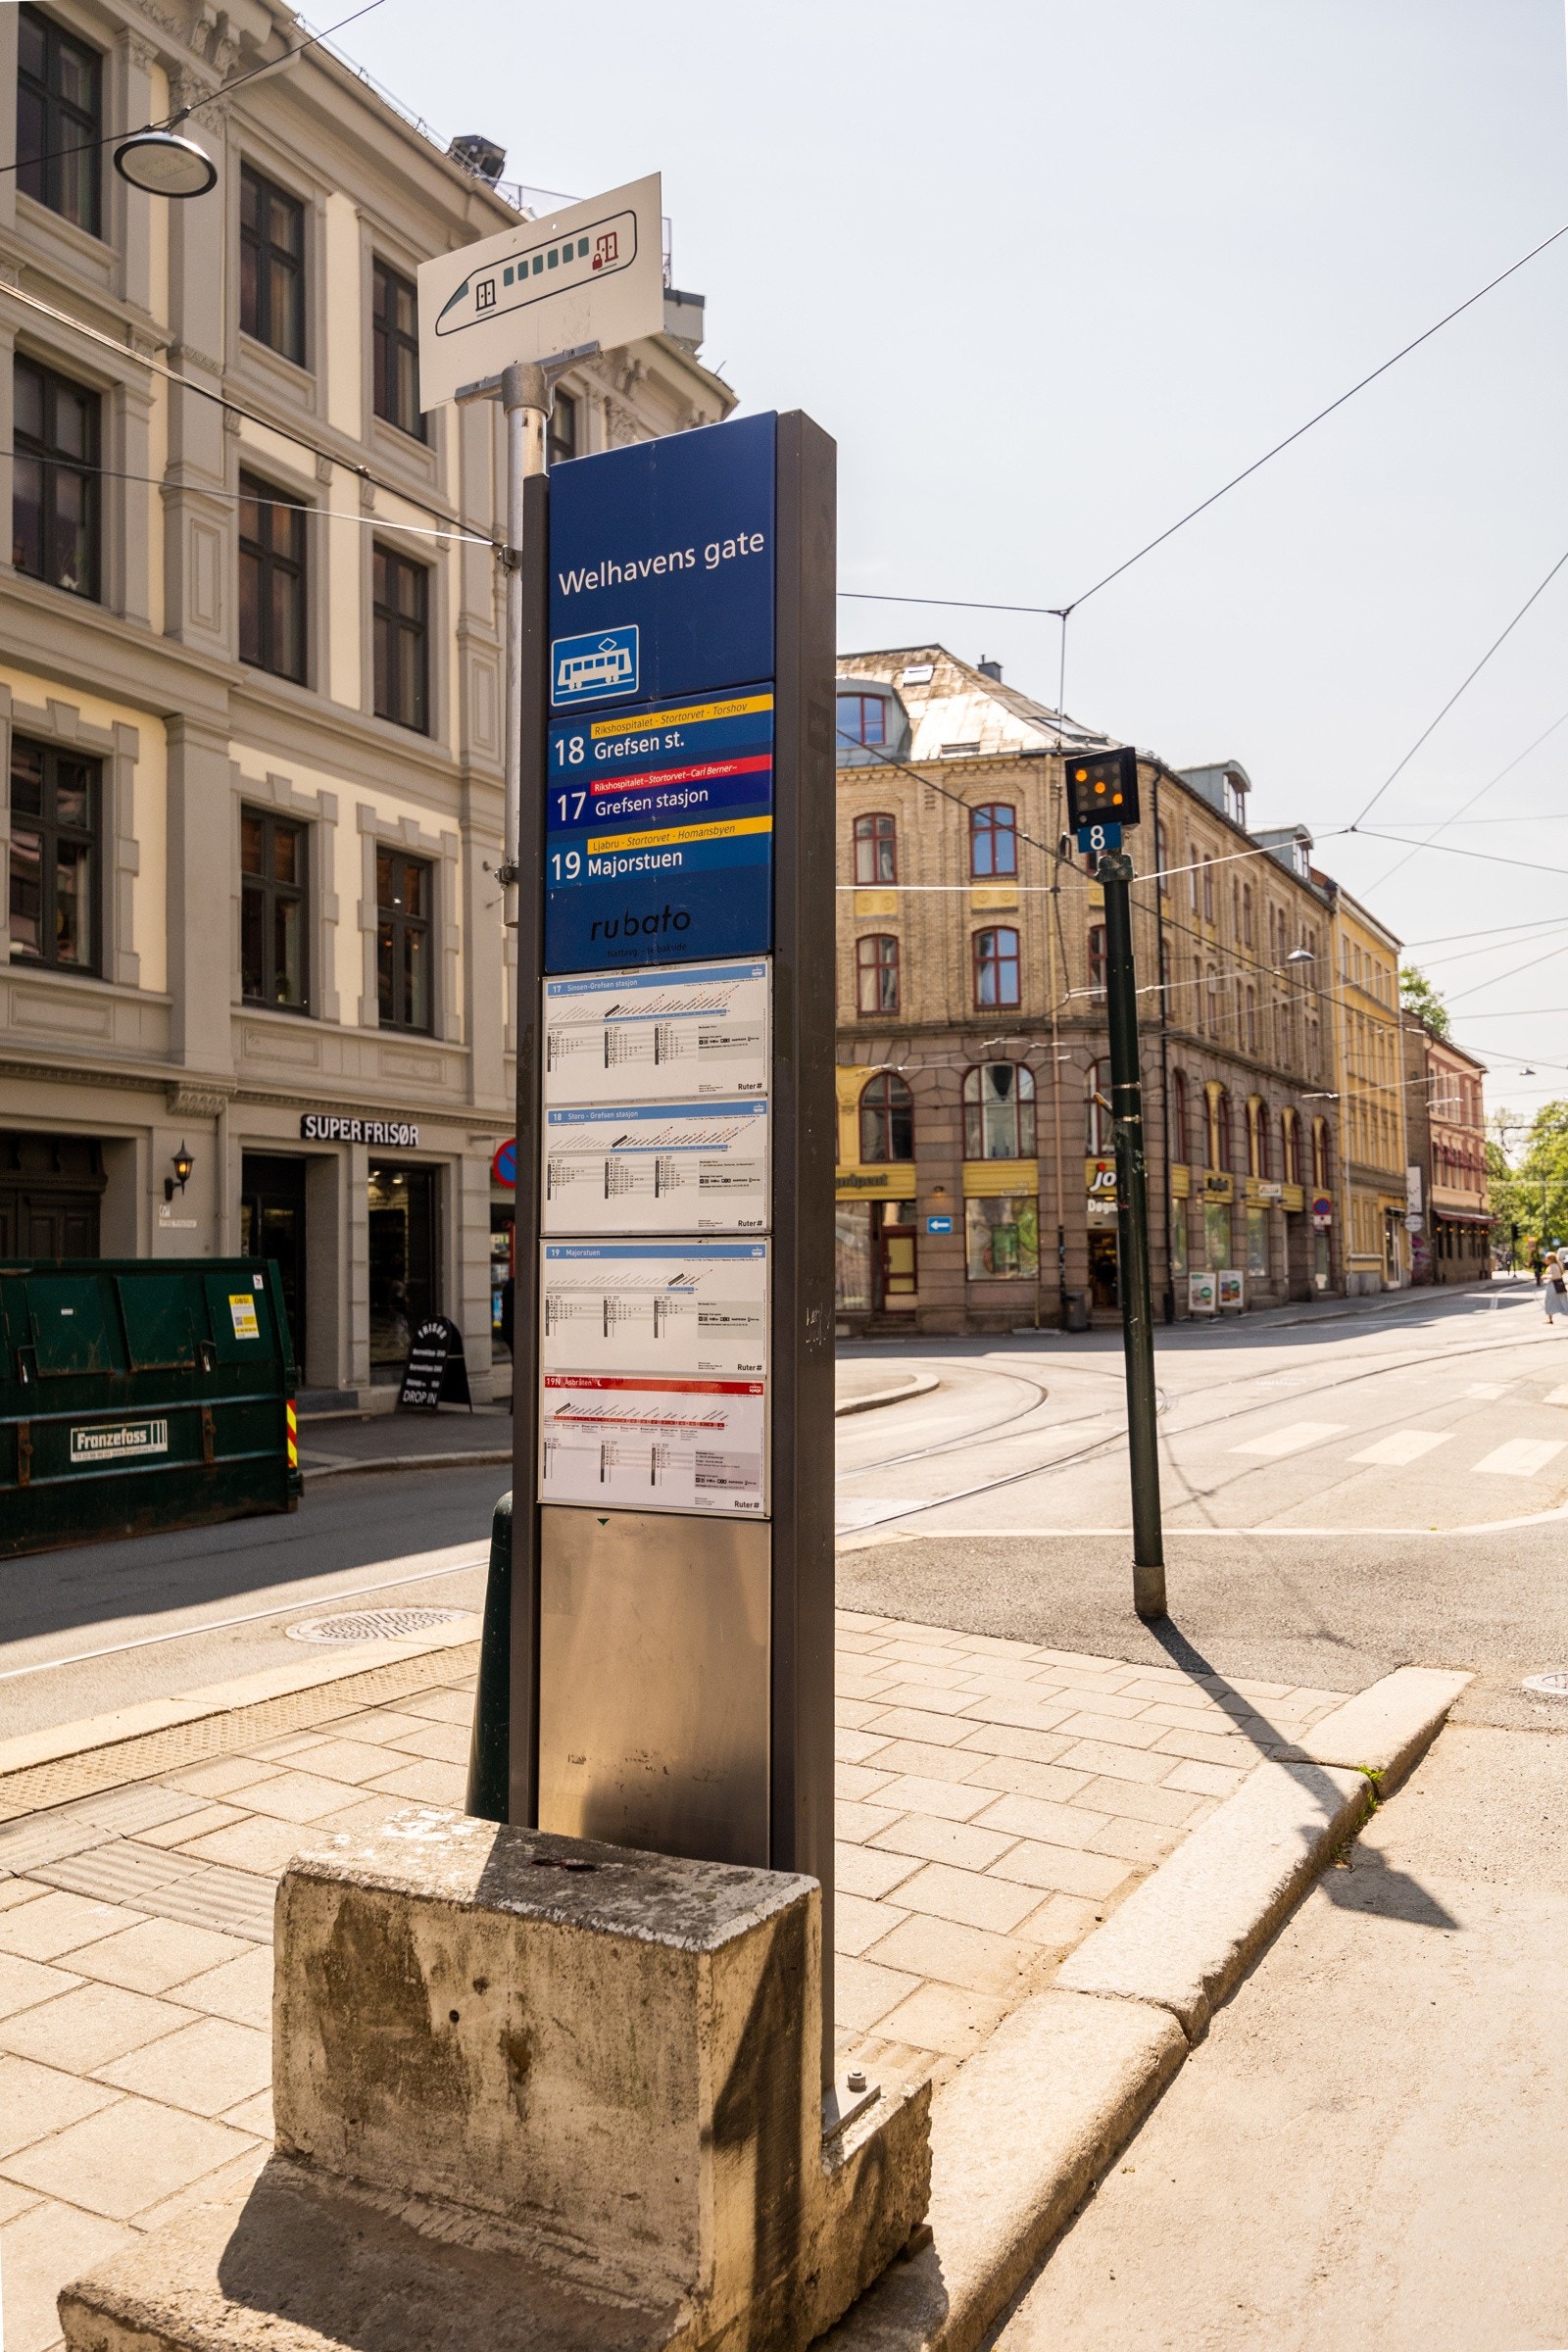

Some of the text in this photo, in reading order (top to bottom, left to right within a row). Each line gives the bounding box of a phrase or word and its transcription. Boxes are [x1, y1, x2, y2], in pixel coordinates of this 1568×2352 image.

[559, 532, 764, 596] Welhavens gate
[595, 716, 654, 736] Rikshospitalet
[661, 709, 705, 724] Stortorvet
[712, 703, 748, 716] Torshov
[555, 736, 585, 766] 18
[594, 731, 685, 760] Grefsen st.
[557, 792, 587, 821] 17
[595, 787, 709, 816] Grefsen stasjon
[593, 840, 619, 853] Ljabru
[627, 833, 670, 847] Stortorvet
[678, 824, 736, 841] Homansbyen
[1090, 825, 1105, 851] 8
[551, 851, 581, 881] 19
[588, 851, 683, 878] Majorstuen
[591, 905, 691, 942] rubato
[614, 979, 638, 989] stasjon
[590, 1110, 615, 1119] Grefsen
[616, 1110, 638, 1120] stasjon
[306, 1115, 418, 1146] SUPER FRISØR
[565, 1249, 601, 1258] Majorstuen
[546, 1377, 561, 1387] 19N
[76, 1428, 148, 1450] Franzefoss
